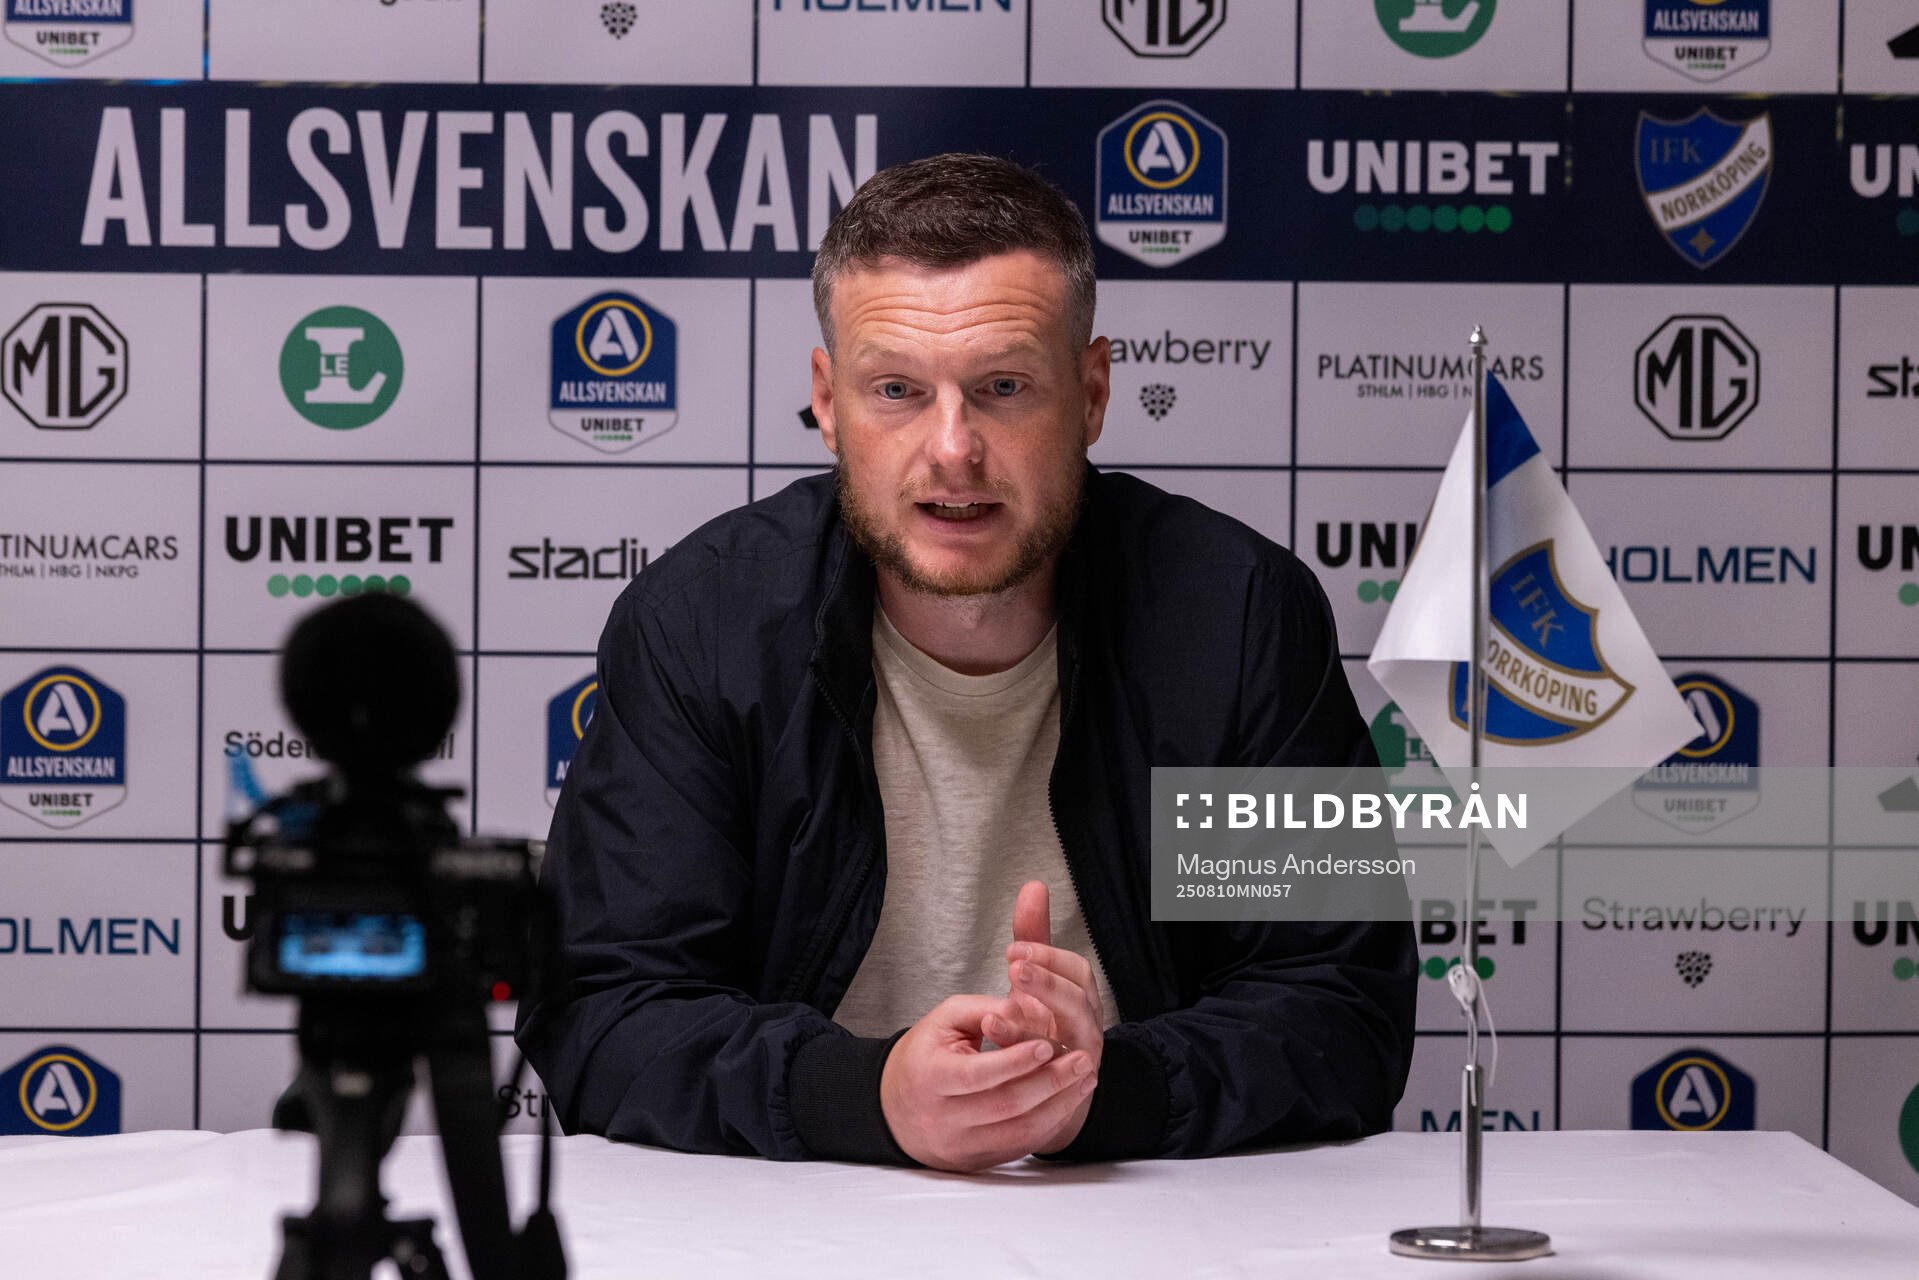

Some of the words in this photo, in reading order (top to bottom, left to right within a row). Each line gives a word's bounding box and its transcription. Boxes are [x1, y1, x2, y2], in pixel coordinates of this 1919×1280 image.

[1653, 9, 1759, 31] ALLSVENSKAN
[36, 31, 100, 45] UNIBET
[1674, 46, 1738, 60] UNIBET
[1651, 137, 1703, 164] IFK
[81, 107, 877, 252] ALLSVENSKAN
[1307, 140, 1559, 195] UNIBET
[1660, 141, 1766, 222] NORRKÖPING
[1108, 193, 1214, 216] ALLSVENSKAN
[1129, 230, 1192, 244] UNIBET
[13, 316, 116, 417] MG
[1318, 354, 1544, 380] PLATINUMARS
[1646, 327, 1749, 429] MG
[1866, 356, 1919, 398] st
[559, 381, 667, 403] ALLSVENSKAN
[1357, 384, 1404, 398] STHLM
[581, 417, 644, 432] UNIBET
[0, 534, 179, 560] TINUMCARS
[225, 516, 454, 562] UNIBET
[95, 565, 139, 578] NKPG
[1509, 573, 1565, 649] IFK
[7, 756, 115, 778] ALLSVENSKAN
[29, 793, 93, 807] UNIBET
[1664, 799, 1727, 813] UNIBET
[1582, 897, 1807, 937] Strawberry
